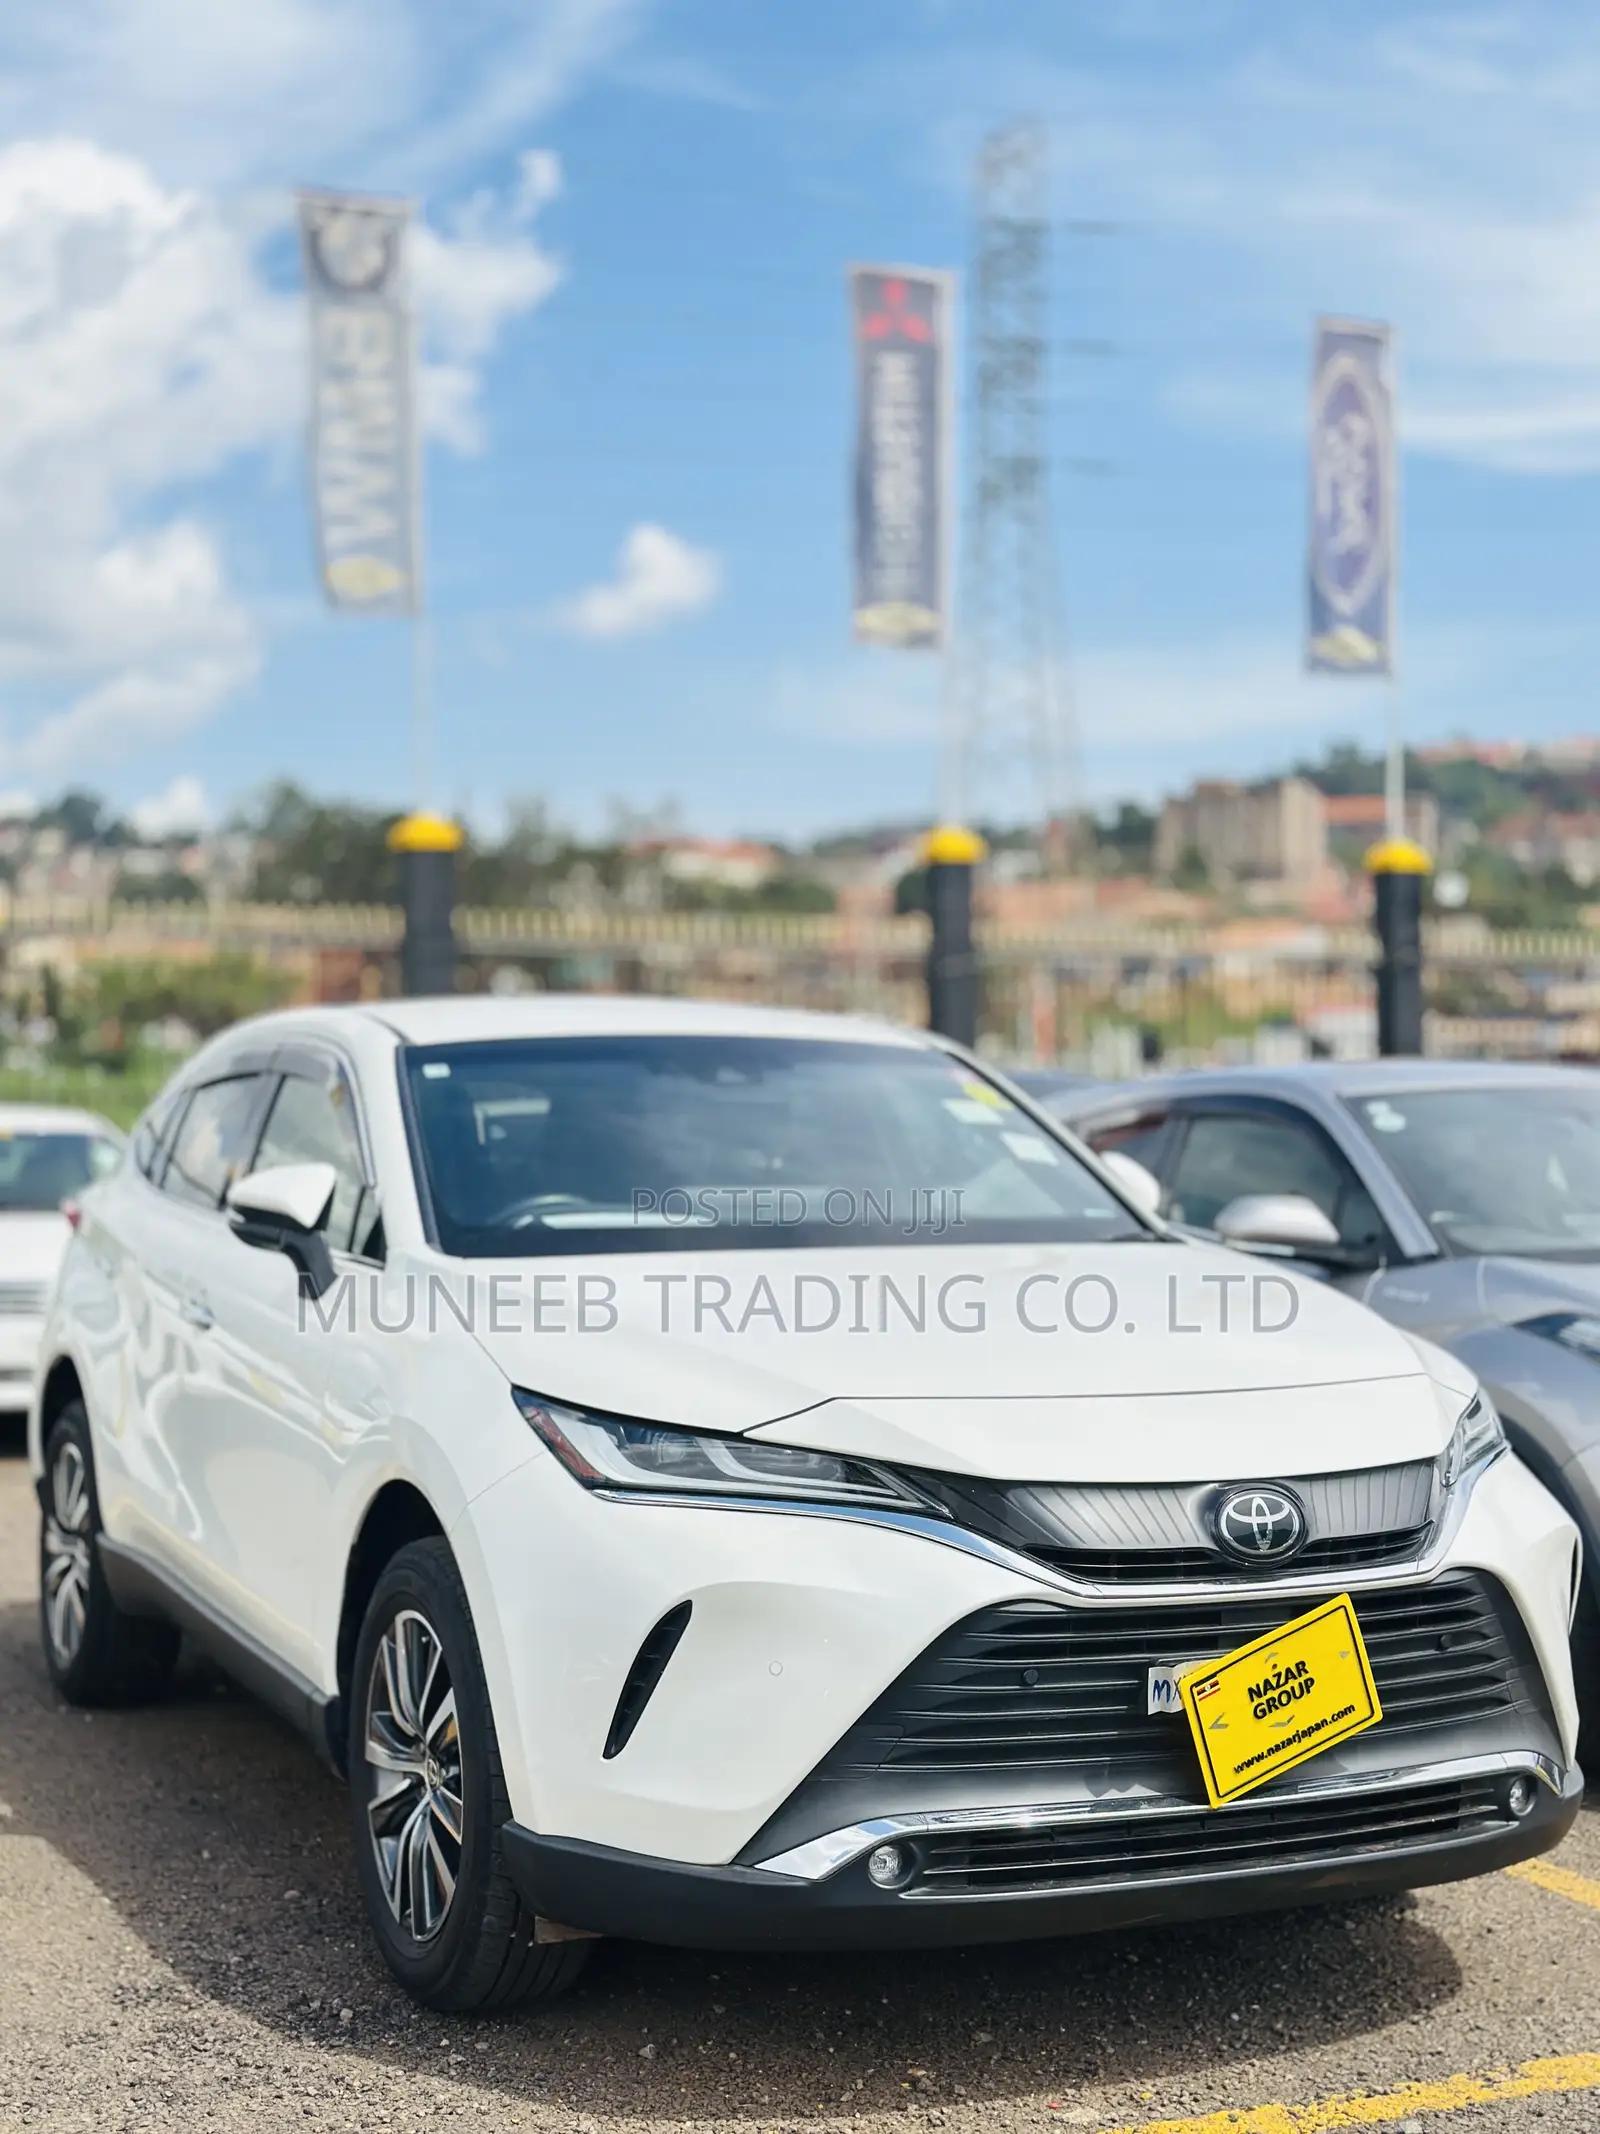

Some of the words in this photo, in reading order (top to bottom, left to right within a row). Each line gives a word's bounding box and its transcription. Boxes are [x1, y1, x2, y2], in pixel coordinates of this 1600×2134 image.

[1153, 1675, 1186, 1704] MX
[1247, 1660, 1309, 1702] NAZAR
[1252, 1677, 1315, 1720] GROUP
[1233, 1704, 1356, 1774] www.nazarjapan.com
